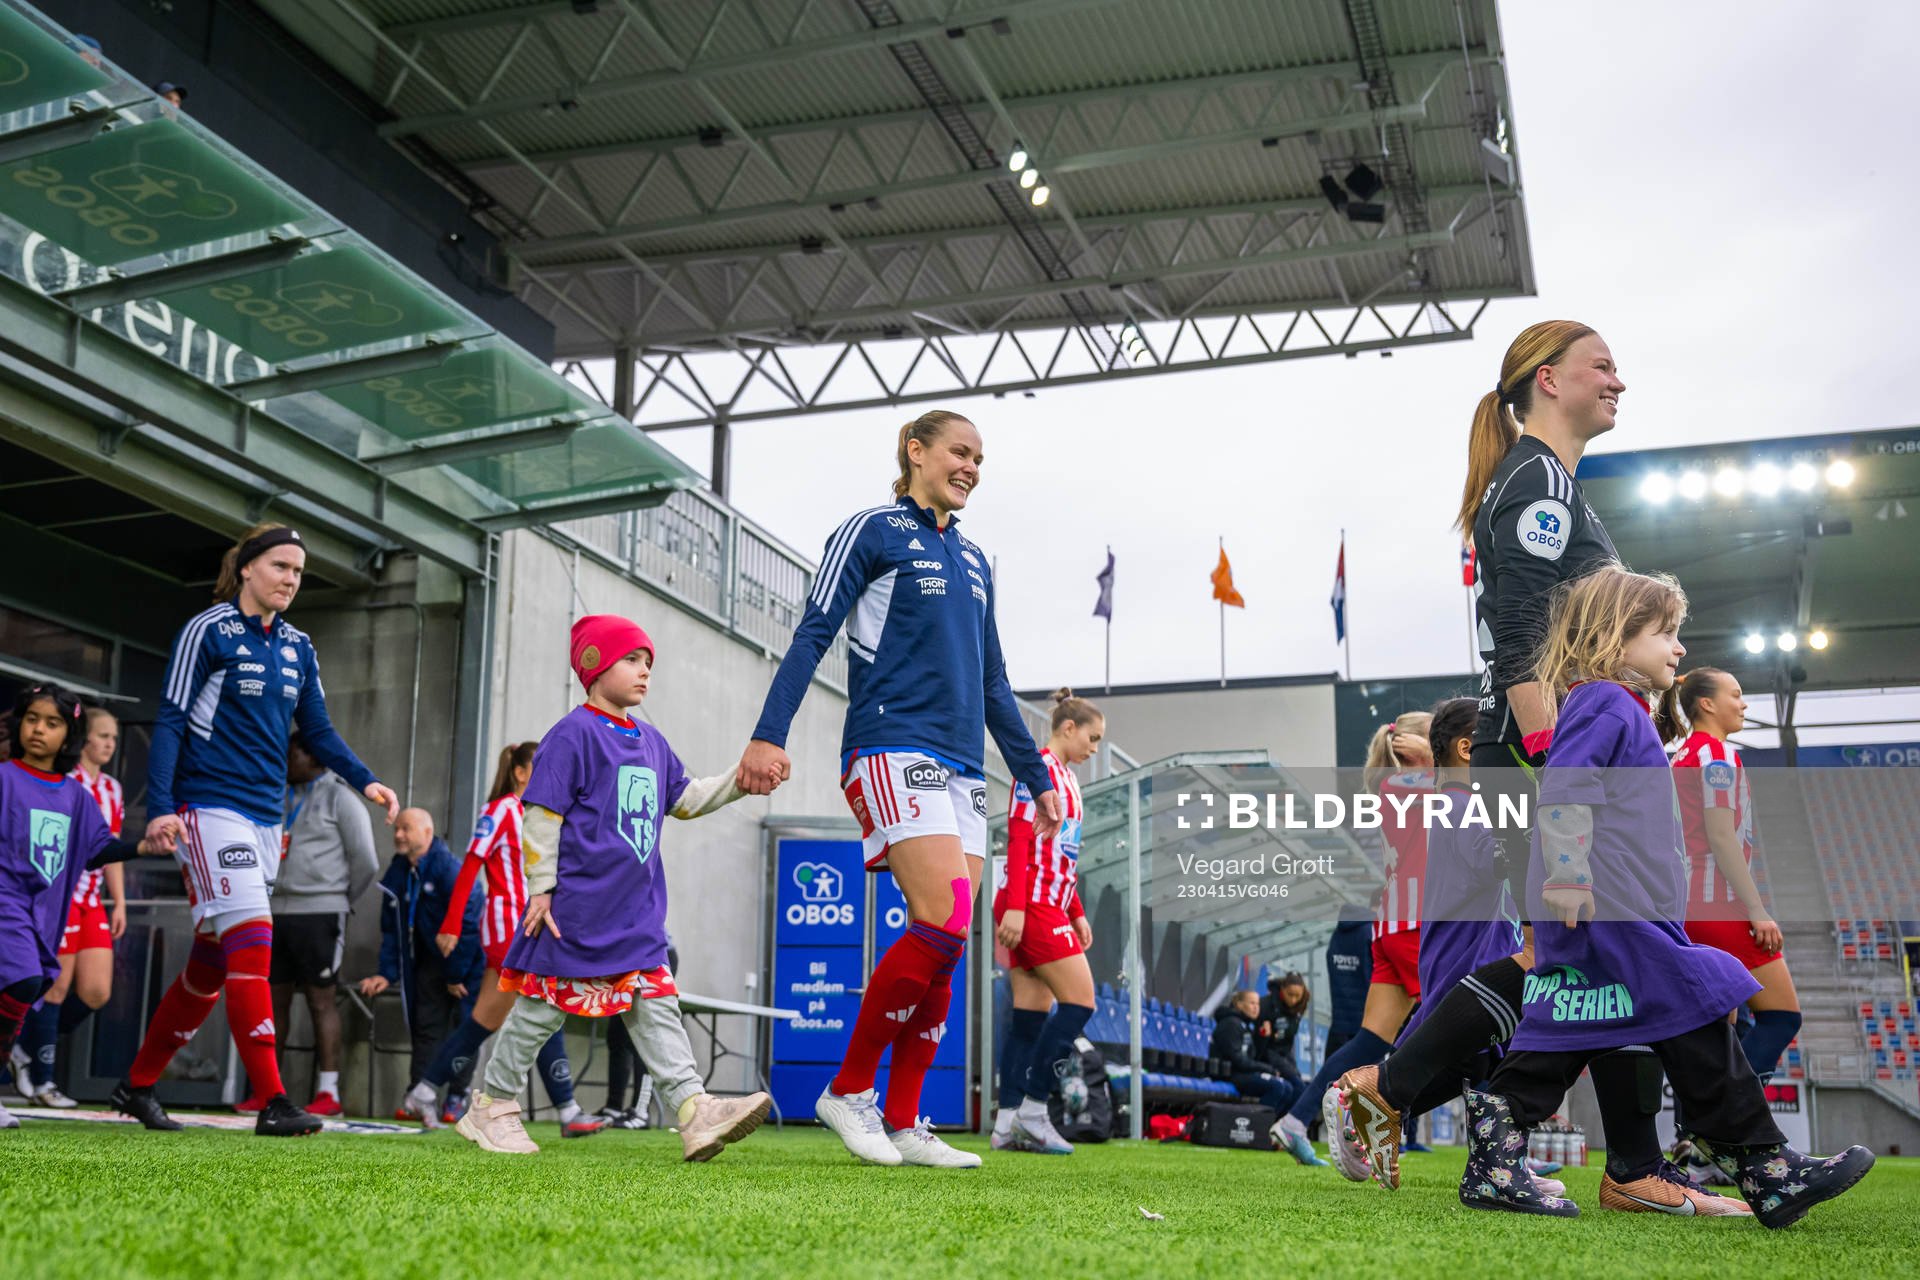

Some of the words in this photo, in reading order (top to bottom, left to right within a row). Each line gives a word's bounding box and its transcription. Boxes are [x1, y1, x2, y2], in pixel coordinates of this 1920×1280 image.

[886, 514, 919, 532] DNB
[1527, 531, 1562, 550] OBOS
[912, 560, 942, 571] coop
[218, 619, 245, 639] DNB
[908, 796, 920, 819] 5
[220, 876, 231, 896] 8
[786, 904, 854, 925] OBOS
[809, 961, 827, 976] Bli
[1552, 983, 1633, 1022] SERIEN
